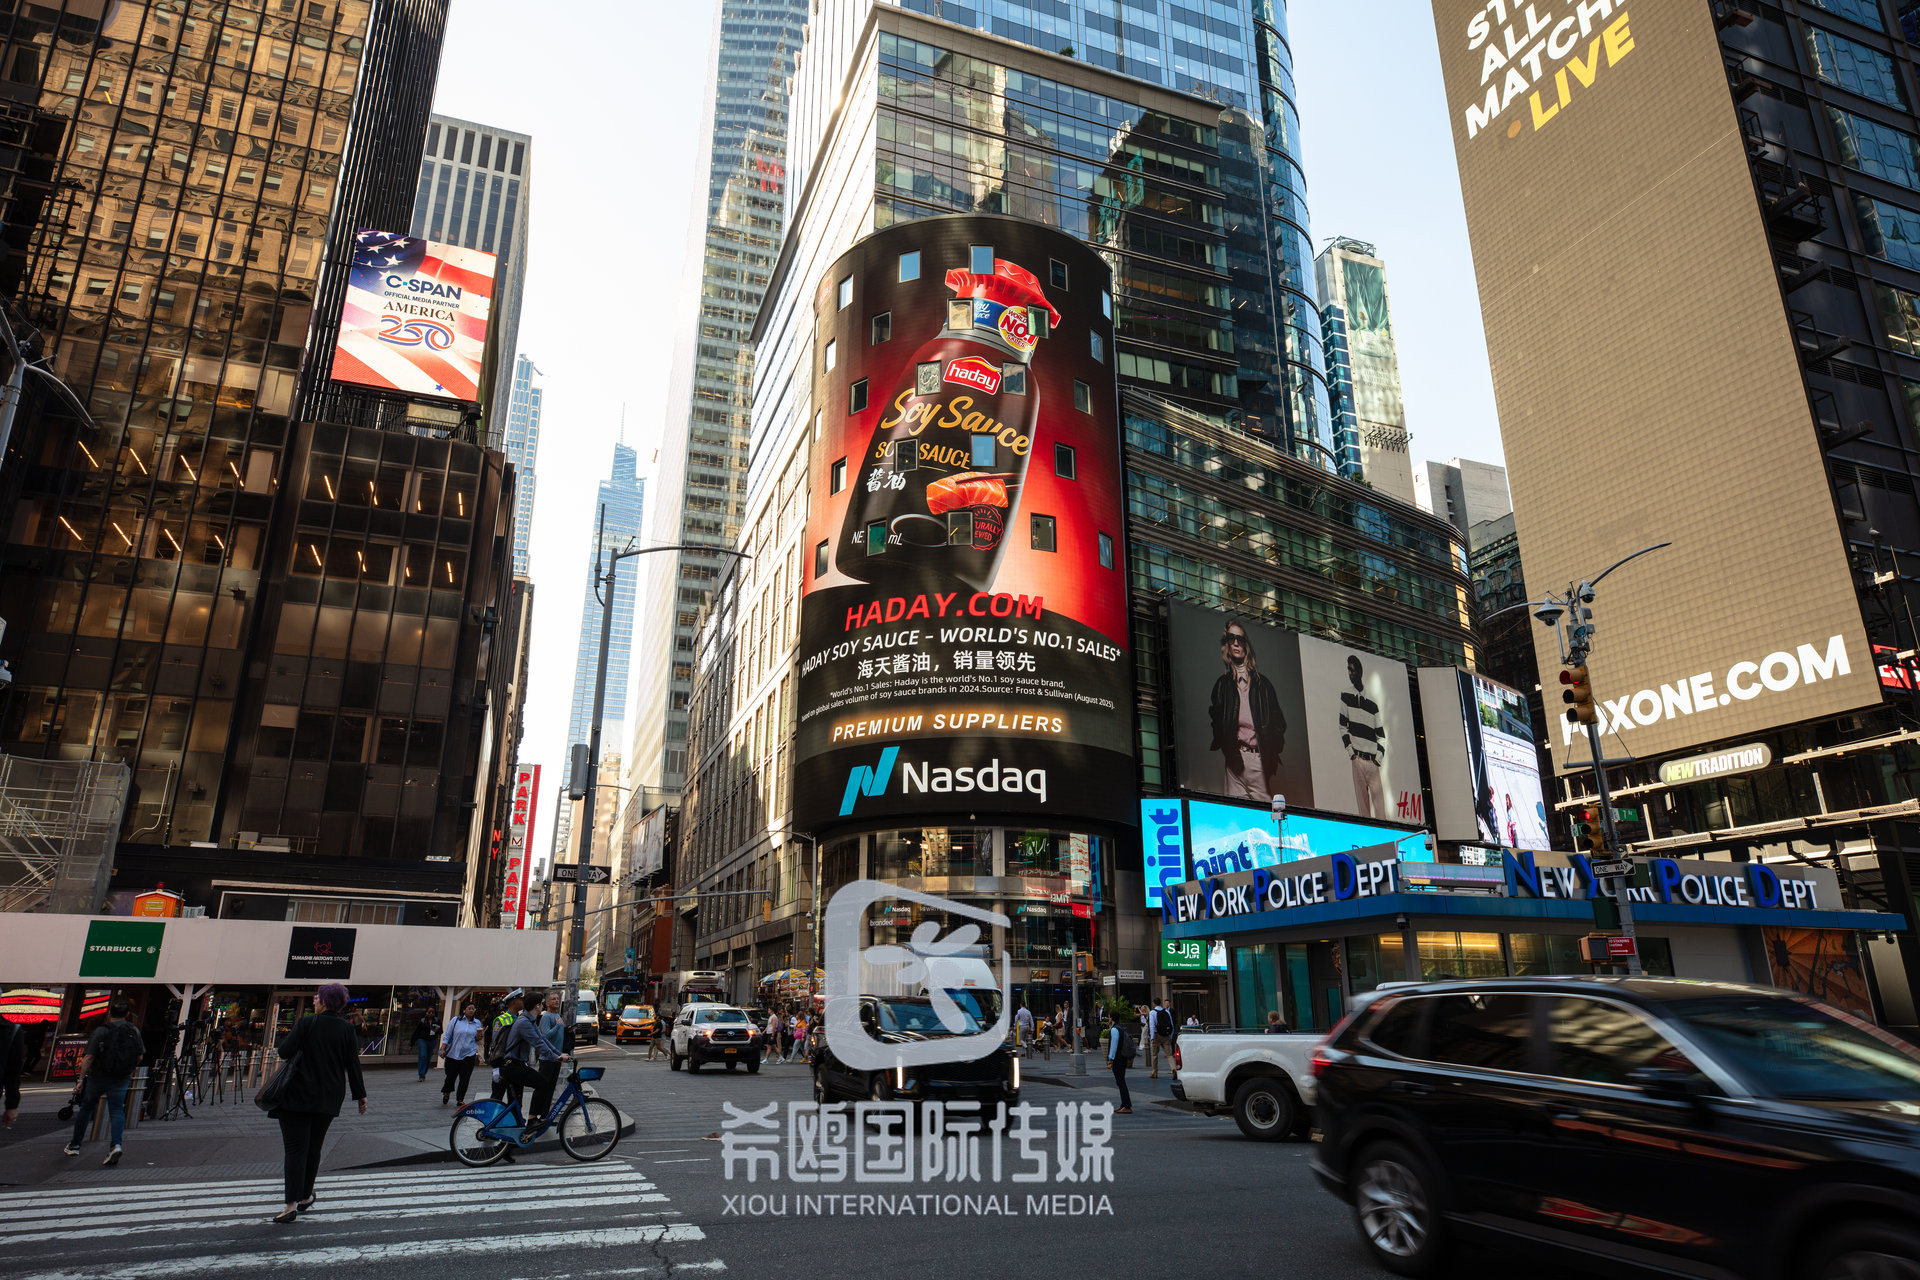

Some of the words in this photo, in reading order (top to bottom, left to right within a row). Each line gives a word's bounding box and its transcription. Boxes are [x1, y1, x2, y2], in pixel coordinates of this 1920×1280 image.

[1480, 2, 1552, 87] ALL
[1465, 0, 1625, 140] MATCH
[1529, 11, 1635, 132] LIVE
[383, 301, 455, 322] AMERICA
[384, 290, 411, 301] OFFICIAL
[412, 296, 432, 304] MEDIA
[432, 300, 460, 309] PARTNER
[378, 315, 455, 351] 250
[948, 363, 997, 391] haday
[880, 388, 942, 436] Soy
[937, 395, 1031, 456] Sauce
[844, 592, 1044, 632] HADAY.COM
[801, 648, 831, 678] HADAY
[831, 638, 860, 661] SOY
[862, 629, 920, 653] SAUCE
[940, 627, 1028, 644] WORLD'S
[1033, 630, 1073, 650] NO.1
[830, 699, 844, 709] sales
[845, 694, 869, 705] volume
[870, 691, 878, 700] of
[879, 691, 892, 700] soy
[893, 688, 917, 697] sauce
[918, 685, 947, 695] brands
[949, 685, 957, 693] in
[1015, 686, 1036, 696] Frost
[1037, 688, 1043, 696] &
[1044, 688, 1073, 700] Sullivan
[1074, 692, 1098, 705] (August
[853, 684, 869, 694] No.1
[871, 681, 892, 690] Sales:
[894, 678, 920, 688] Haday
[922, 676, 928, 684] is
[930, 676, 944, 684] the
[945, 675, 977, 683] world's
[978, 675, 998, 683] No.1
[1000, 676, 1015, 685] soy
[1016, 677, 1039, 686] sauce
[1041, 678, 1066, 689] brand,
[833, 715, 923, 742] PREMIUM
[933, 713, 1063, 733] SUPPLIERS
[513, 772, 531, 825] PARK
[902, 758, 1047, 804] Nasdaq
[1397, 790, 1422, 823] H&M
[503, 857, 521, 913] PARK
[561, 869, 578, 877] ONE
[1502, 848, 1576, 898] NEW
[1654, 858, 1750, 906] POLICE
[1751, 863, 1818, 909] DEPT
[1595, 865, 1609, 874] ONE
[1614, 863, 1629, 872] WAY
[1160, 885, 1199, 924] NEW
[1199, 877, 1250, 919] YORK
[1253, 868, 1325, 912] POLICE
[1331, 853, 1397, 900] DEPT
[1026, 906, 1047, 914] Nasdaq
[89, 945, 143, 953] STARBUCKS
